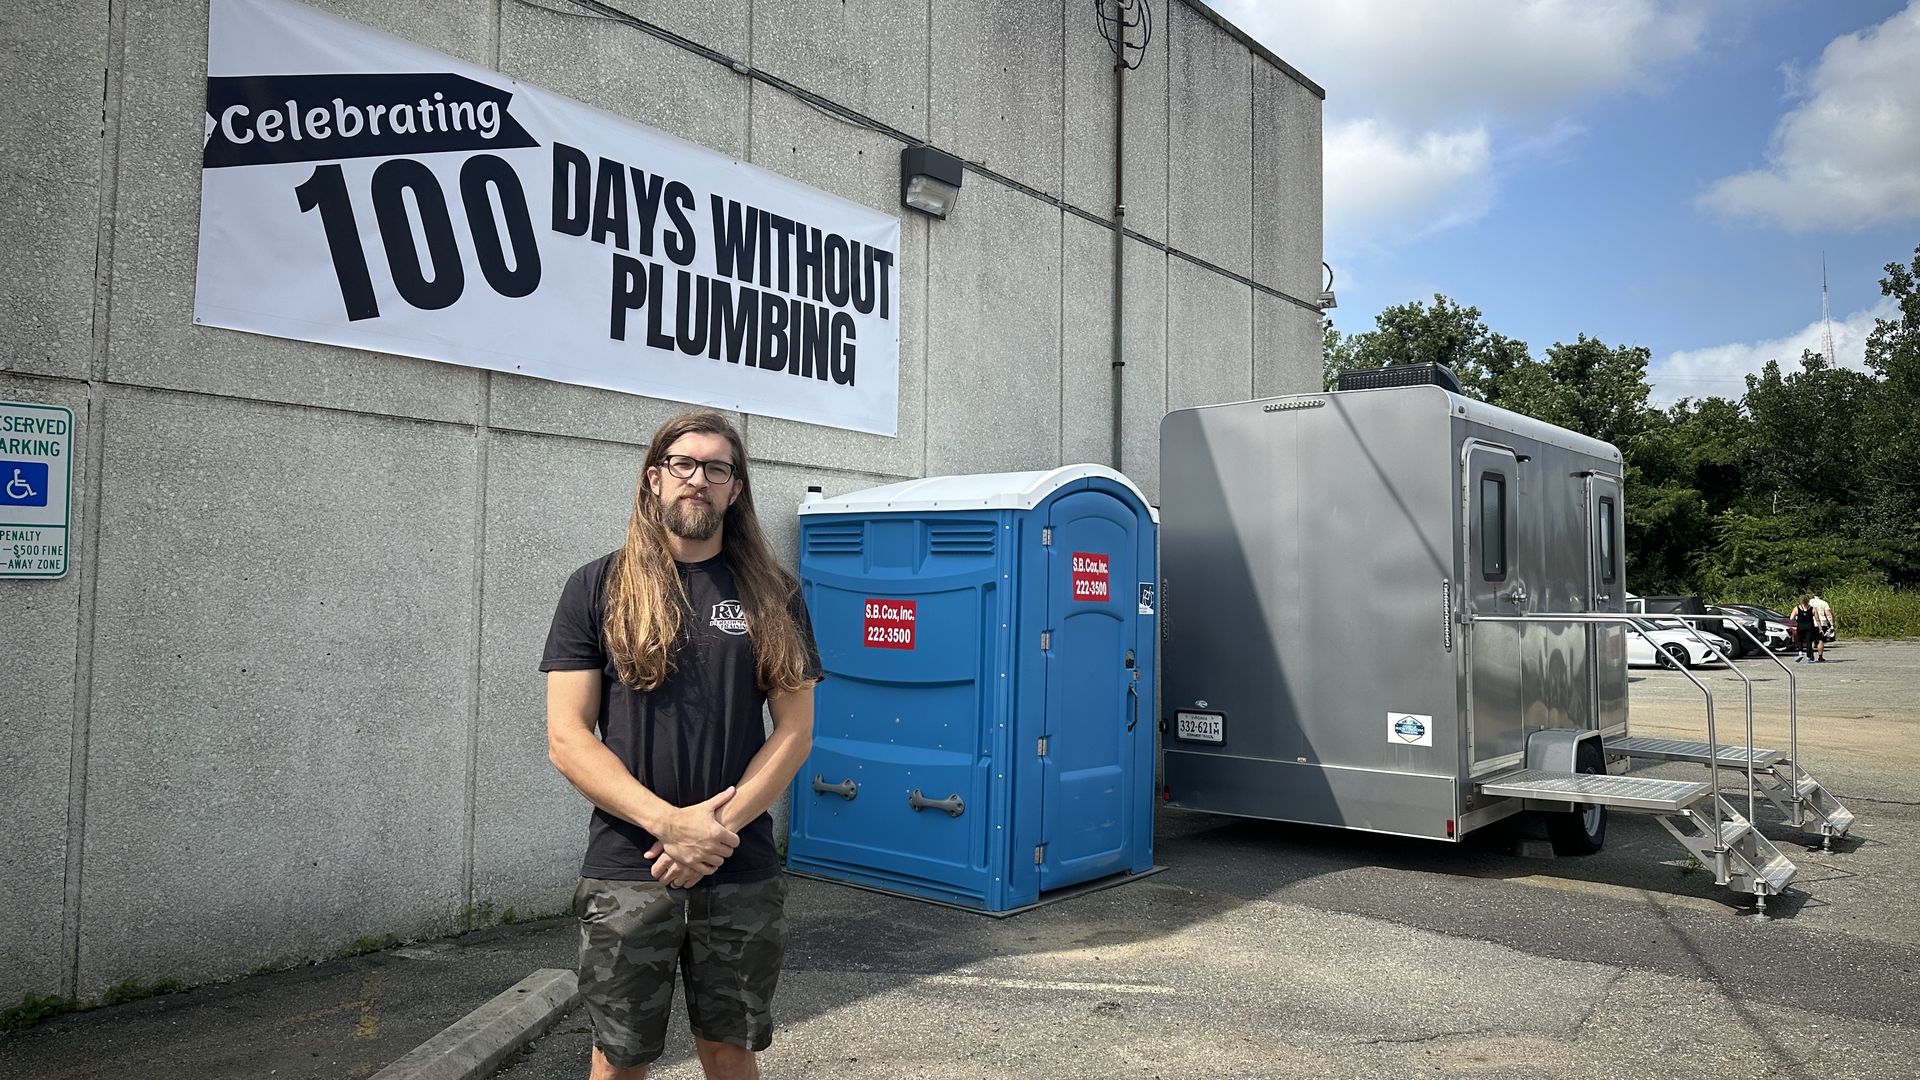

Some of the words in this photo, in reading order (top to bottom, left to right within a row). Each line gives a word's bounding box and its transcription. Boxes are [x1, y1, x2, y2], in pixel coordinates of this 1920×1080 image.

[221, 92, 501, 144] Celebrating
[294, 154, 542, 322] 100
[551, 142, 695, 266] DAYS
[710, 193, 893, 320] WITHOUT
[610, 254, 856, 387] PLUMBING
[0, 415, 67, 435] SERVED
[0, 530, 41, 542] PENALTY
[42, 545, 63, 556] FINE
[37, 559, 61, 569] ZONE
[1075, 579, 1107, 595] 222-3500
[865, 603, 881, 619] S.B.
[881, 604, 899, 622] Cox,
[900, 605, 915, 620] Inc.
[867, 626, 911, 643] 222-3500
